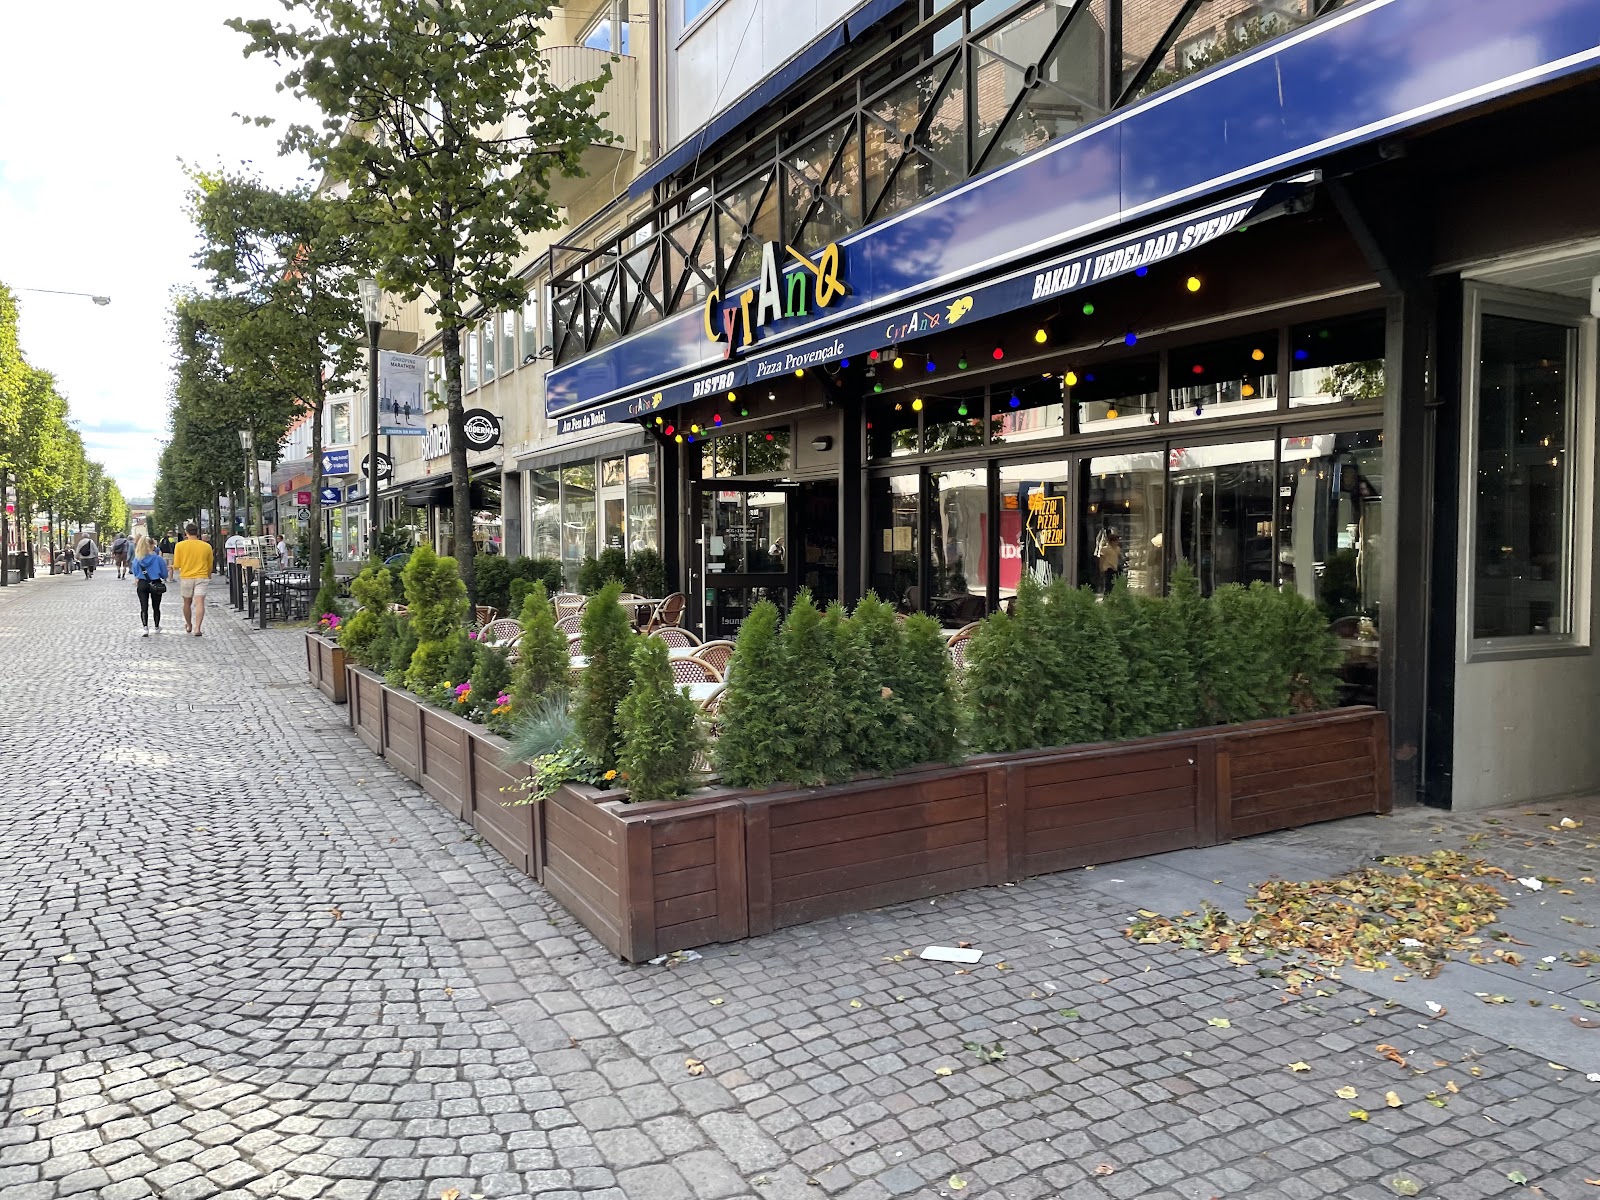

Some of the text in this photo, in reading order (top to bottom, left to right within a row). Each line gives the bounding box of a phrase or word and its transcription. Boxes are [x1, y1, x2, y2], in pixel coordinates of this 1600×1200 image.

[1032, 262, 1080, 301] BAKAD
[1081, 258, 1091, 285] I
[1091, 232, 1178, 282] VEDELDAD
[390, 362, 416, 370] MARATHON
[756, 339, 844, 378] Pizza Provençale
[692, 371, 735, 398] BISTRO
[562, 410, 606, 433] Au Feu de Bois!
[463, 424, 499, 435] RÖDERNAS
[1035, 500, 1057, 515] PIZZA!
[1037, 514, 1060, 529] PIZZA!
[1040, 529, 1063, 544] PIZZA!
